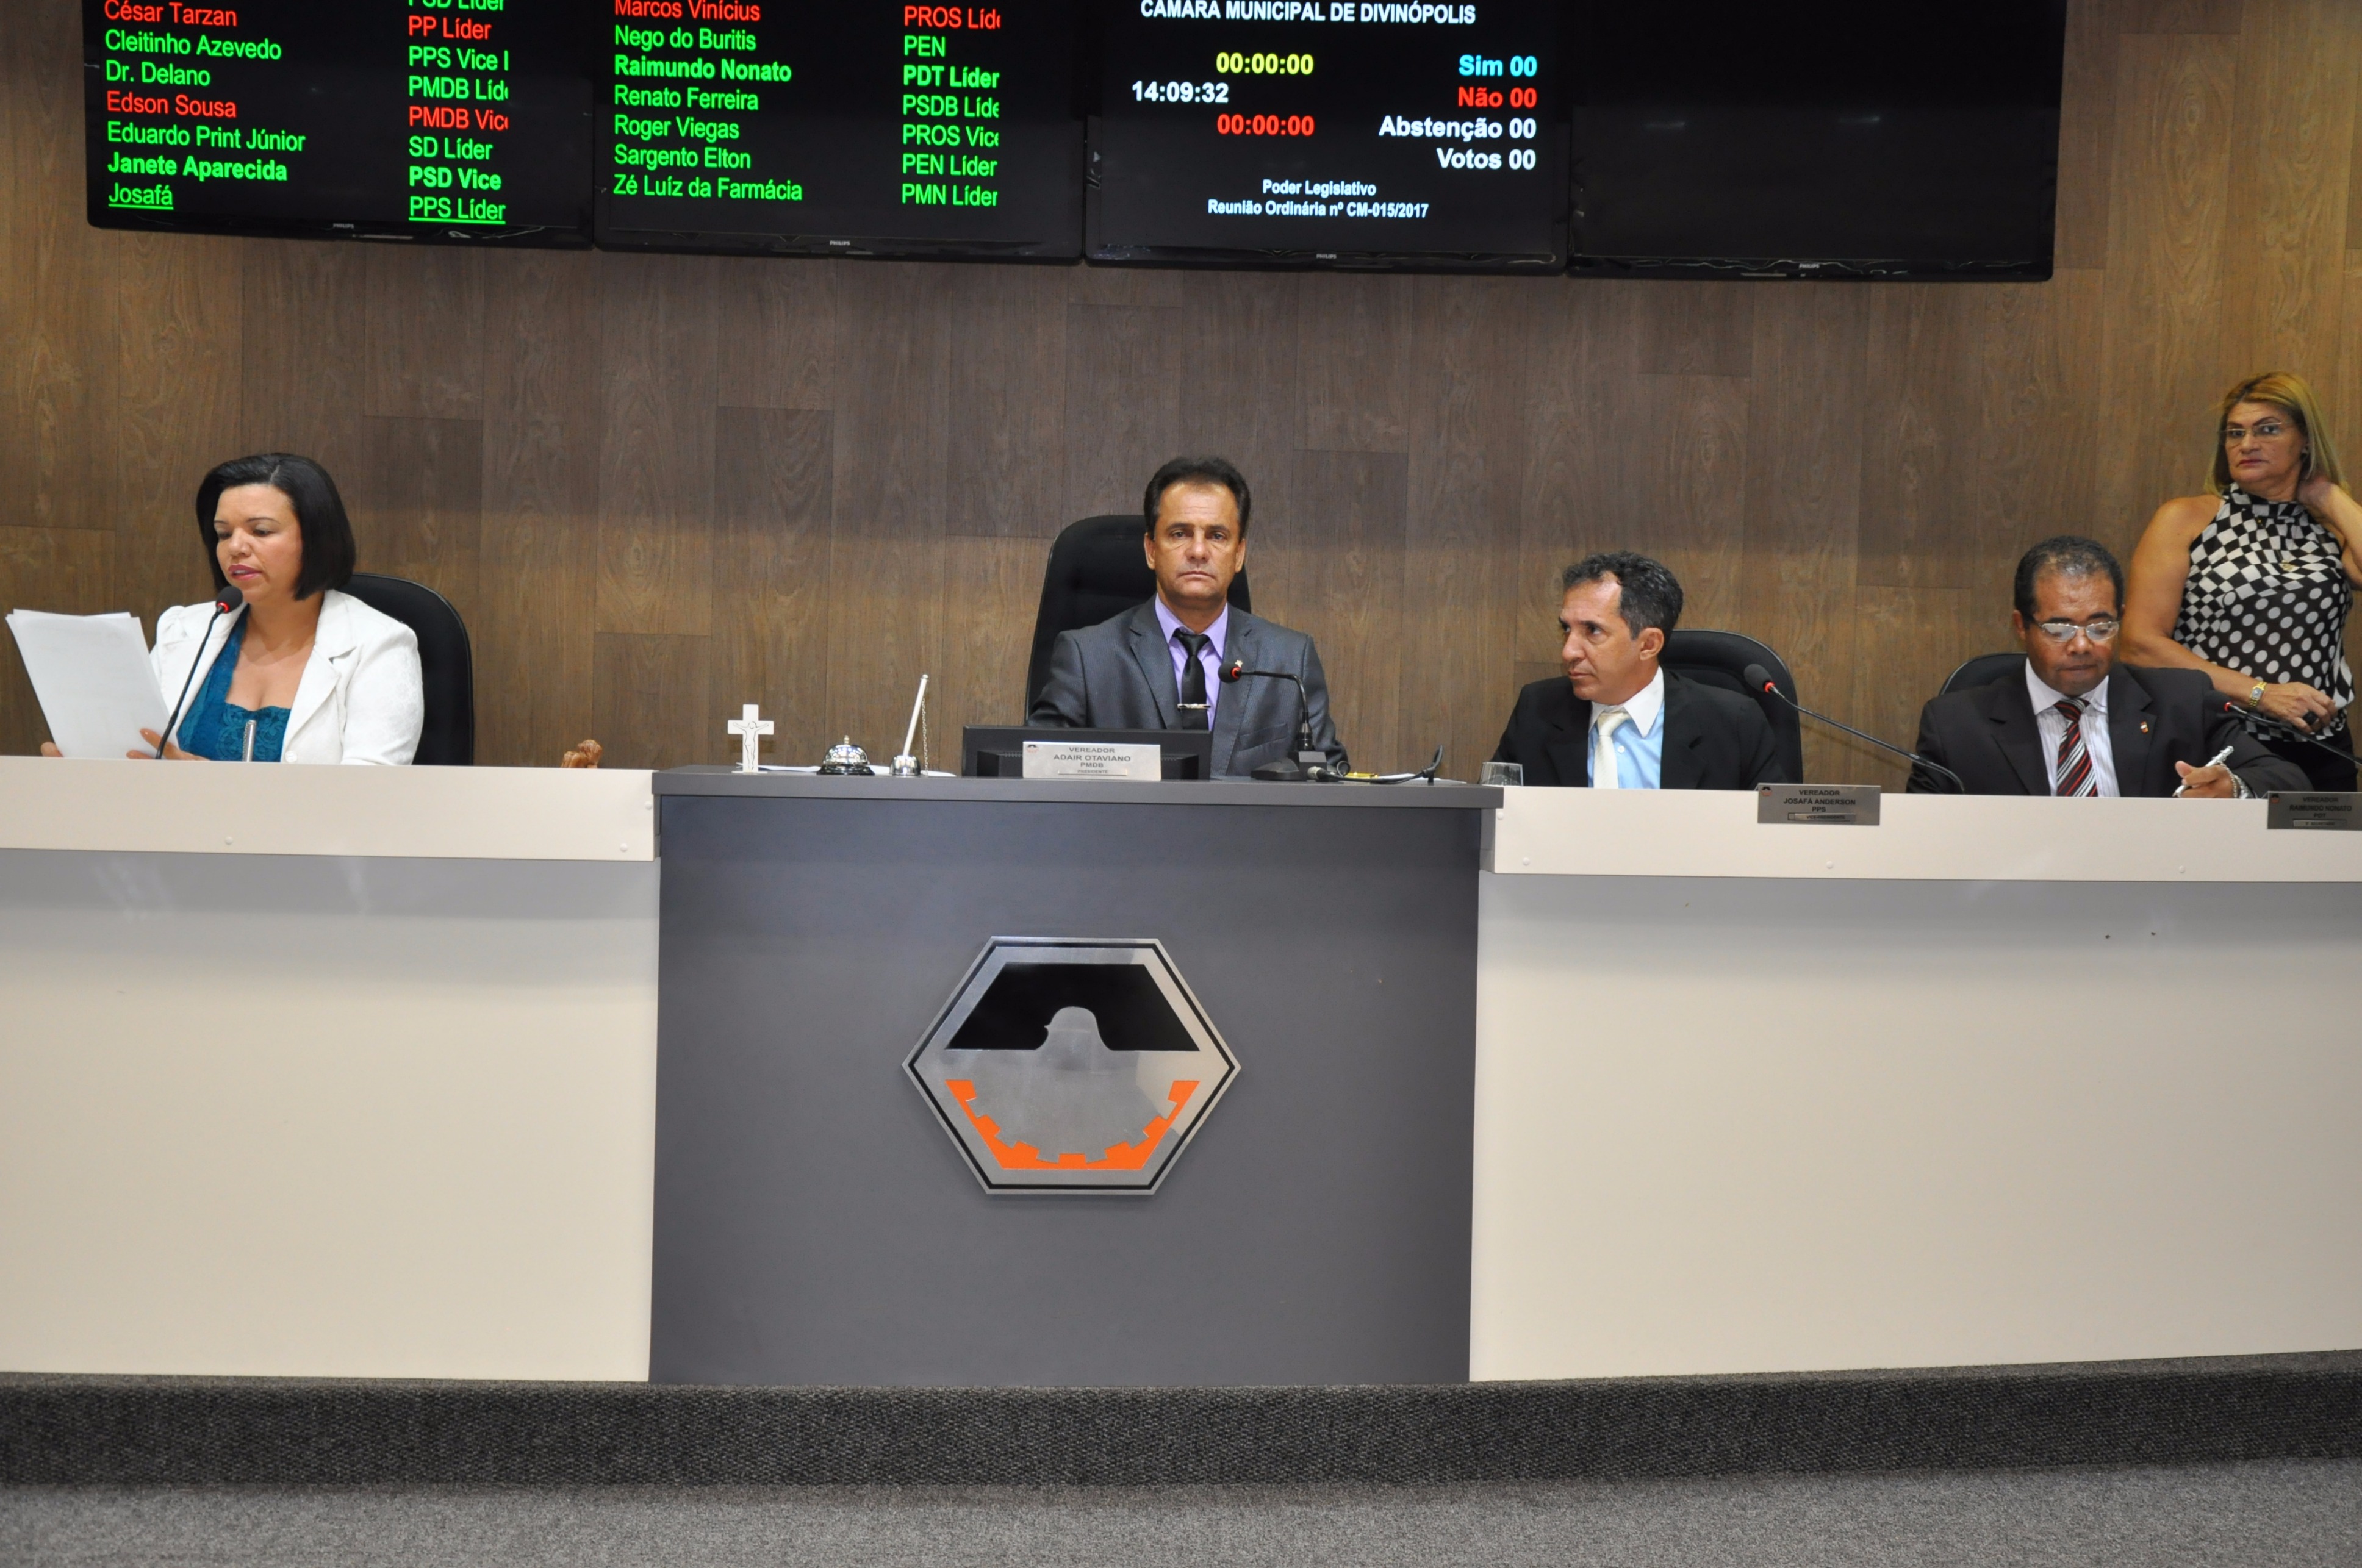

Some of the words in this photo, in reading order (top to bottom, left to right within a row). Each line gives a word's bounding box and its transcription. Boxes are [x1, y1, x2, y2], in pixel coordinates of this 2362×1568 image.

[105, 0, 163, 22] César
[169, 2, 237, 26] Tarzan
[616, 0, 682, 18] Marcos
[688, 0, 760, 21] Vinícius
[905, 5, 961, 28] PROS
[1226, 1, 1325, 21] MUNICIPAL
[1330, 2, 1355, 21] DE
[1360, 0, 1476, 24] DIVINÓPOLIS
[409, 15, 437, 36] PP
[443, 18, 492, 39] Líder
[616, 25, 664, 51] Nego
[670, 27, 693, 48] do
[700, 28, 756, 51] Buritis
[106, 29, 190, 54] Cleitinho
[196, 35, 281, 59] Azevedo
[905, 35, 945, 57] PEN
[409, 46, 451, 68] PPS
[457, 48, 498, 70] Vice
[615, 55, 715, 79] Raimundo
[722, 59, 791, 81] Nonato
[1216, 52, 1313, 74] 00:00:00
[1459, 55, 1502, 76] Sim
[1510, 55, 1537, 77] 00
[106, 60, 134, 82] Dr.
[142, 62, 210, 86] Delano
[904, 65, 944, 86] PDT
[950, 66, 999, 88] Líder
[409, 76, 469, 99] PMDB
[615, 85, 681, 107] Renato
[687, 87, 758, 110] Ferreira
[1132, 81, 1229, 103] 14:09:32
[1459, 87, 1503, 107] Não
[1510, 88, 1537, 108] 00
[107, 91, 168, 113] Edson
[176, 95, 236, 118] Sousa
[903, 95, 958, 116] PSDB
[409, 106, 469, 129] PMDB
[615, 114, 671, 141] Roger
[676, 116, 739, 143] Viegas
[1218, 114, 1314, 136] 00:00:00
[1379, 116, 1502, 142] Abstenção
[1509, 118, 1536, 138] 00
[108, 121, 190, 145] Eduardo
[196, 126, 241, 148] Print
[246, 129, 306, 151] Júnior
[409, 135, 438, 157] SD
[445, 138, 493, 159] Líder
[903, 124, 960, 146] PROS
[108, 152, 177, 175] Janete
[183, 156, 287, 181] Aparecida
[615, 144, 698, 171] Sargento
[705, 147, 750, 168] Elton
[903, 153, 944, 174] PEN
[950, 155, 997, 176] Líder
[1437, 148, 1502, 169] Votos
[1509, 149, 1535, 170] 00
[410, 166, 452, 188] PSD
[458, 168, 501, 190] Vice
[614, 174, 637, 195] Zé
[644, 175, 683, 196] Luíz
[688, 177, 711, 197] da
[718, 177, 802, 201] Farmácia
[1263, 179, 1302, 195] Poder
[1305, 180, 1376, 198] Legislativo
[109, 182, 173, 206] Josafá
[902, 184, 946, 204] PMN
[953, 185, 997, 206] Líder
[410, 196, 451, 218] PPS
[458, 198, 506, 220] Líder
[1208, 199, 1262, 215] Reunião
[1265, 200, 1326, 216] Ordinária
[1346, 202, 1429, 218] CM-015/2017
